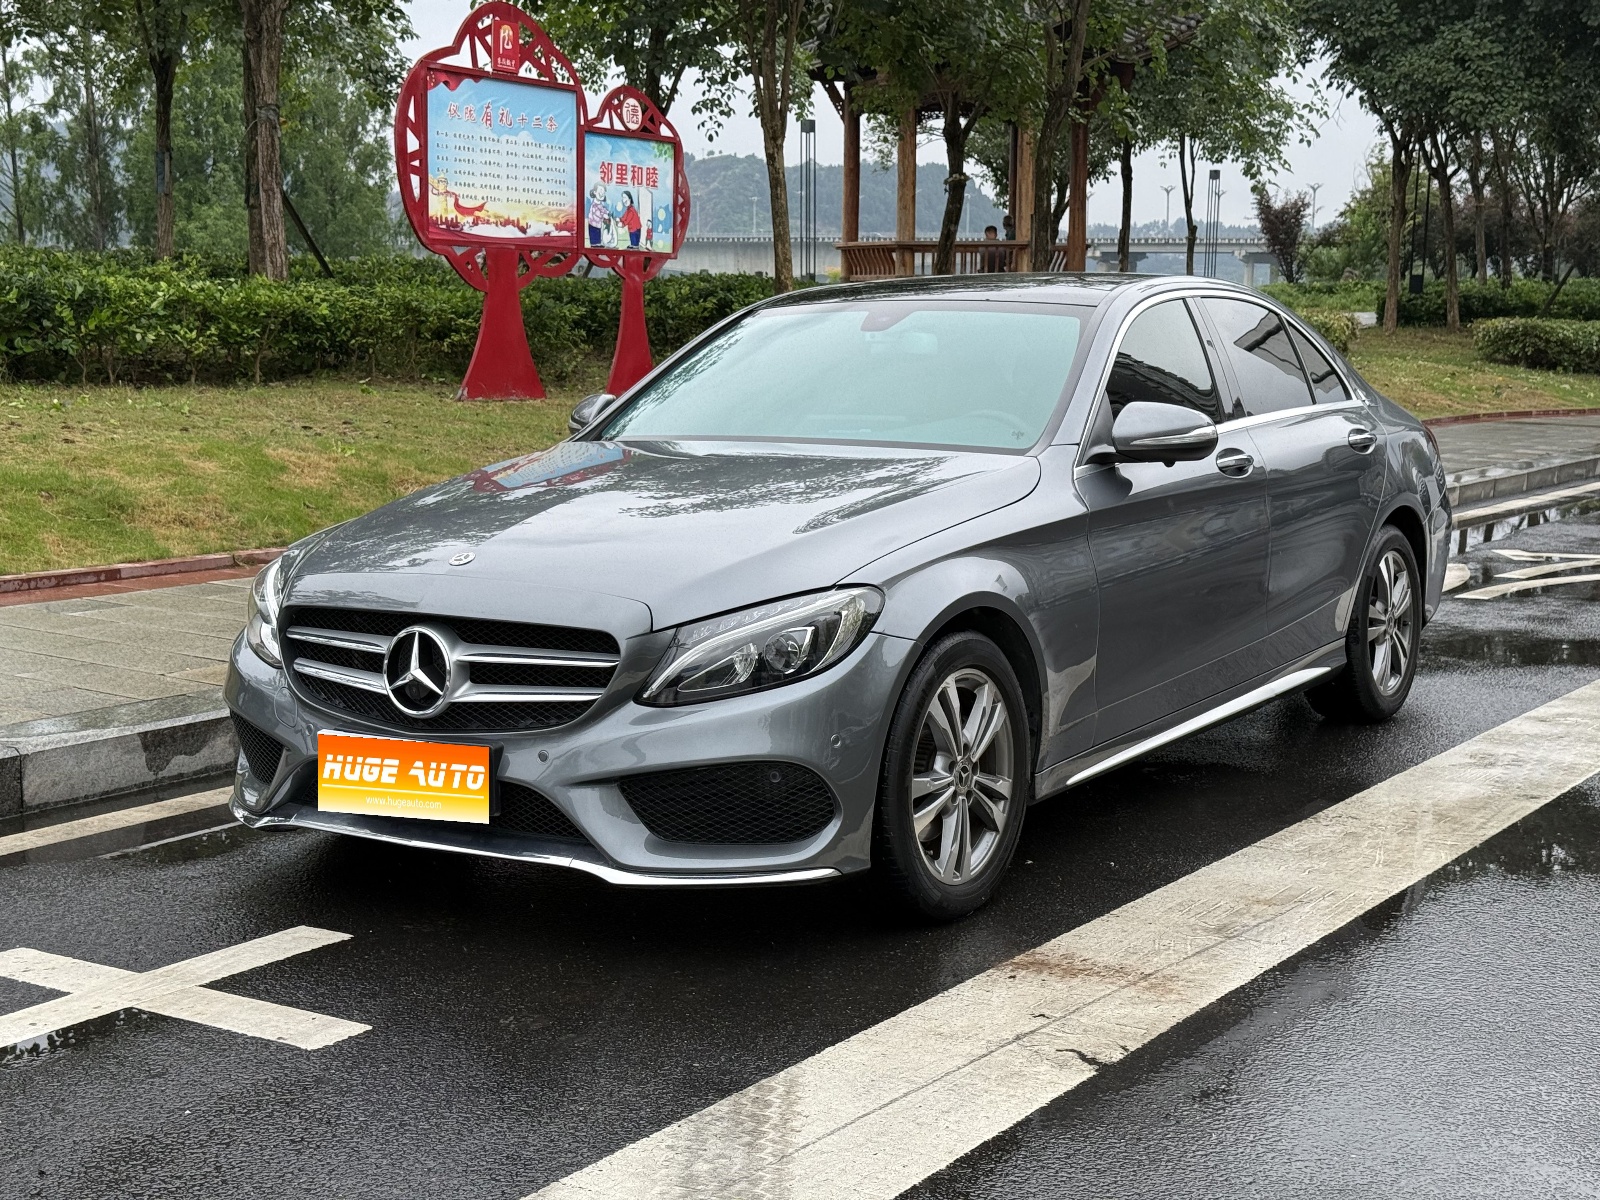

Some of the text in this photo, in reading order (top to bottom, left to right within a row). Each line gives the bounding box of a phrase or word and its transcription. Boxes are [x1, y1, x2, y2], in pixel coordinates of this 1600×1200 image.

[447, 101, 559, 132] 仪陇有礼十二条
[599, 161, 659, 188] 邻里和睦
